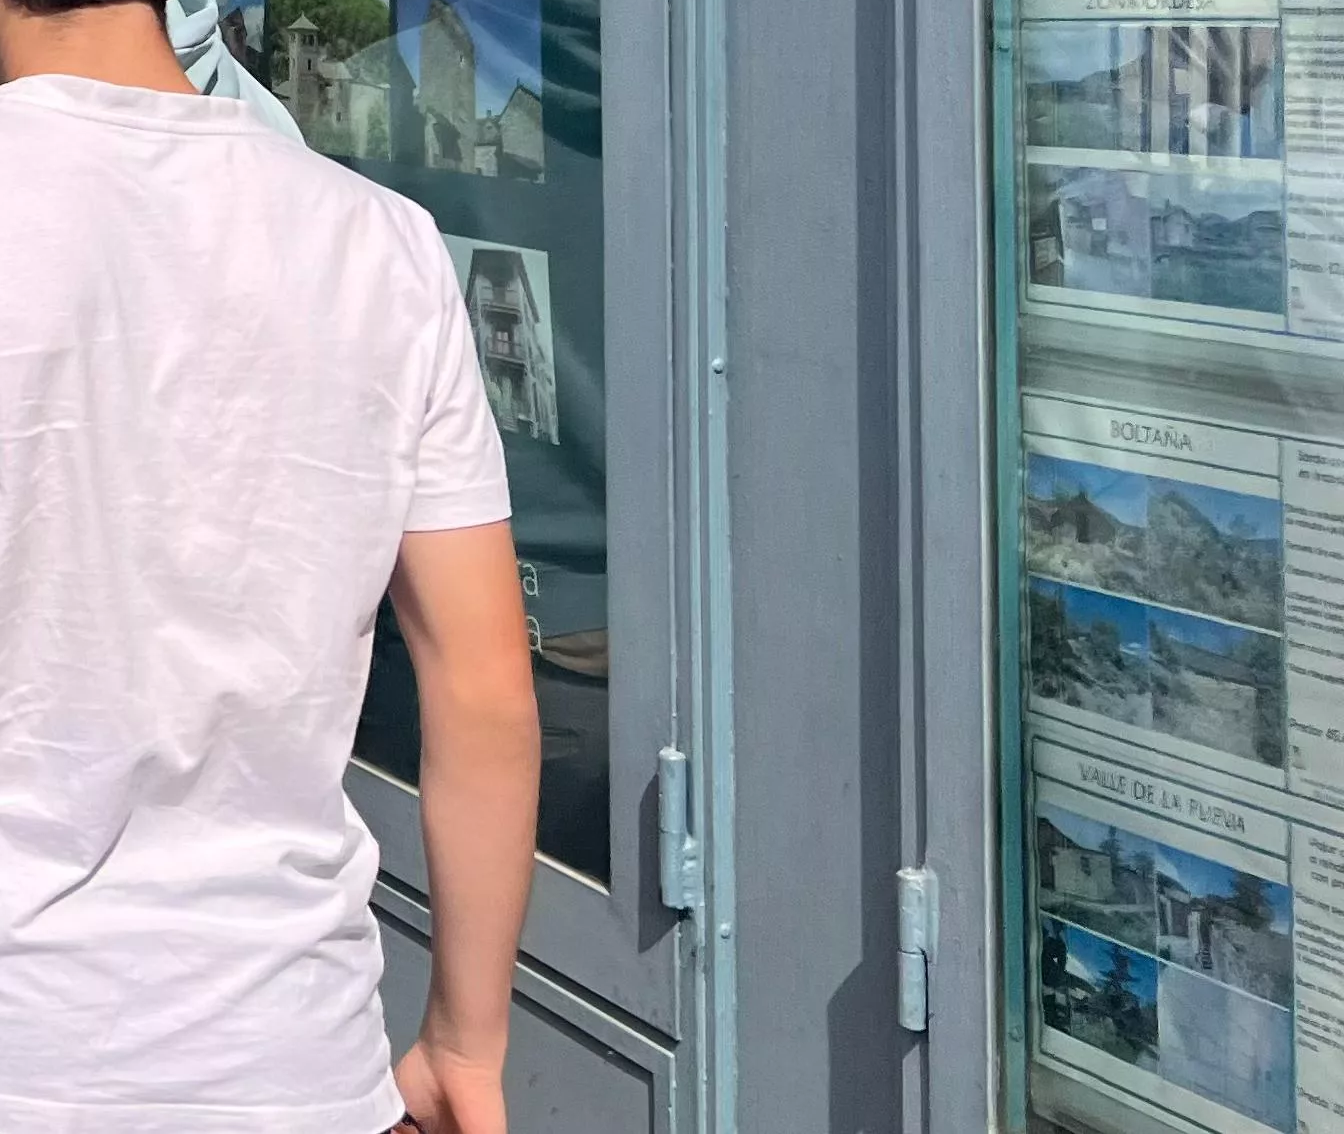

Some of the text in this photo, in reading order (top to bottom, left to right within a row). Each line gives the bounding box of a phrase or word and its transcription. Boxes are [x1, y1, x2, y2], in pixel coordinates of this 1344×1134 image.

[1110, 419, 1193, 452] BOLTAÑA
[1078, 761, 1127, 795] VALLE
[1131, 779, 1154, 804] DE
[1159, 789, 1182, 812] LA
